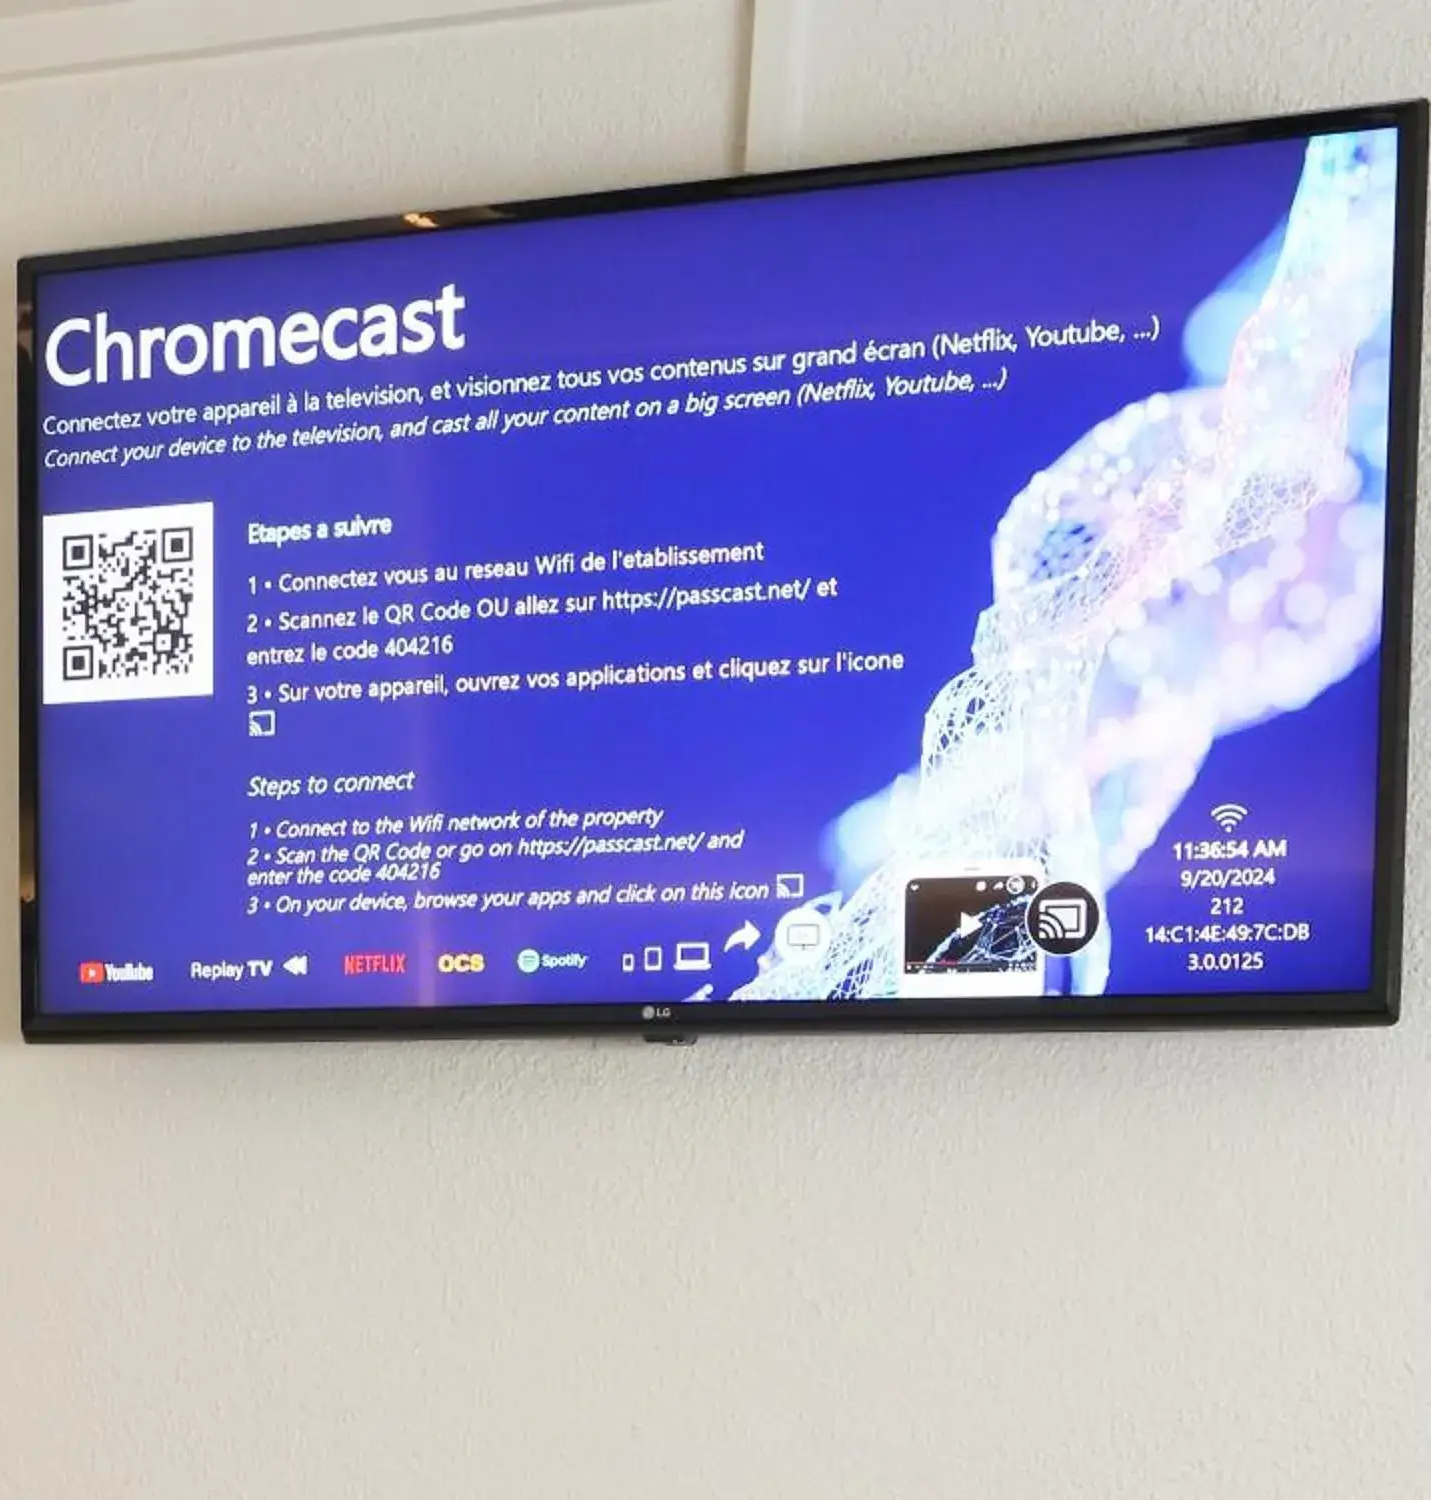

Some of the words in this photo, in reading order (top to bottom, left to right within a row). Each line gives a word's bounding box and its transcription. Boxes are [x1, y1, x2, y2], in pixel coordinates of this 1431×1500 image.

[44, 283, 466, 387] Chromecast
[42, 411, 142, 435] Connectez
[146, 405, 198, 427] votre
[202, 392, 281, 426] appareil
[286, 391, 298, 414] à
[304, 390, 320, 412] la
[325, 383, 424, 411] television,
[430, 380, 452, 401] et
[455, 374, 552, 398] visionnez
[556, 370, 602, 390] tous
[606, 366, 645, 385] vos
[650, 357, 748, 381] contenus
[752, 353, 787, 373] sur
[792, 339, 858, 375] grand
[862, 339, 926, 363] écran
[931, 327, 1018, 361] (Netflix,
[1024, 319, 1126, 349] Youtube,
[44, 445, 119, 468] Connect
[120, 444, 165, 467] your
[168, 434, 228, 458] device
[232, 434, 252, 453] to
[256, 429, 288, 450] the
[292, 421, 384, 447] television,
[389, 415, 429, 439] and
[432, 413, 472, 435] cast
[474, 408, 500, 431] all
[500, 409, 550, 435] your
[552, 399, 631, 425] content
[634, 399, 662, 417] on
[666, 399, 680, 415] a
[684, 391, 720, 417] big
[722, 389, 791, 411] screen
[796, 377, 876, 408] (Netflix,
[885, 369, 975, 397] Youtube,
[248, 522, 312, 547] Etapes
[316, 522, 329, 539] a
[333, 513, 393, 538] suivre
[248, 575, 256, 595] 1
[278, 569, 378, 593] Connectez
[383, 567, 429, 586] vous
[434, 565, 458, 583] au
[464, 561, 529, 580] reseau
[534, 552, 575, 575] Wifi
[580, 551, 606, 573] de
[612, 543, 765, 571] l'etablissement
[246, 613, 258, 634] 2
[278, 610, 357, 631] Scannez
[362, 605, 380, 625] le
[384, 603, 415, 626] QR
[420, 599, 472, 622] Code
[476, 597, 509, 619] OU
[514, 594, 560, 616] allez
[565, 595, 597, 613] sur
[602, 577, 812, 614] https://passcast.net/
[816, 577, 838, 597] et
[246, 647, 305, 667] entrez
[310, 641, 328, 662] le
[332, 639, 380, 662] code
[384, 633, 454, 657] 404216
[246, 684, 258, 705] 3
[278, 683, 310, 703] Sur
[313, 681, 363, 701] votre
[368, 673, 449, 703] appareil,
[455, 673, 520, 693] ouvrez
[526, 671, 560, 689] vos
[565, 662, 686, 692] applications
[692, 660, 714, 681] et
[718, 657, 792, 683] cliquez
[797, 657, 831, 675] sur
[836, 651, 905, 673] l'icone
[246, 775, 302, 801] Steps
[307, 775, 328, 795] to
[333, 770, 416, 794] connect
[250, 821, 258, 839] 1
[276, 819, 348, 839] Connect
[351, 819, 371, 836] to
[374, 815, 404, 835] the
[409, 813, 445, 833] Wifi
[447, 810, 522, 832] network
[524, 808, 548, 829] of
[548, 808, 580, 829] the
[581, 807, 664, 832] property
[246, 847, 260, 867] 2
[277, 846, 316, 864] Scan
[320, 843, 350, 864] the
[354, 843, 381, 864] QR
[385, 840, 431, 863] Code
[437, 844, 458, 860] or
[458, 843, 485, 863] go
[488, 842, 514, 858] on
[517, 831, 706, 860] https://passcast.net/
[706, 828, 746, 850] and
[1172, 839, 1250, 861] 11:36:54
[1251, 838, 1288, 859] AM
[246, 869, 294, 887] enter
[296, 865, 325, 885] the
[328, 863, 372, 884] code
[375, 862, 442, 882] 404216
[1180, 867, 1276, 890] 9/20/2024
[246, 895, 259, 915] 3
[275, 895, 302, 914] On
[302, 897, 348, 917] your
[348, 891, 408, 913] device,
[412, 889, 479, 910] browse
[480, 891, 526, 913] your
[526, 889, 572, 911] apps
[575, 883, 613, 905] and
[615, 883, 658, 904] click
[660, 886, 686, 903] on
[690, 881, 726, 902] this
[728, 880, 770, 901] icon
[1210, 896, 1244, 915] 212
[190, 959, 245, 982] Replay
[246, 959, 274, 977] TV
[344, 953, 406, 976] NETFLIX
[438, 953, 485, 974] OCS
[541, 953, 586, 969] Spotify
[1188, 951, 1264, 971] 3.0.0125
